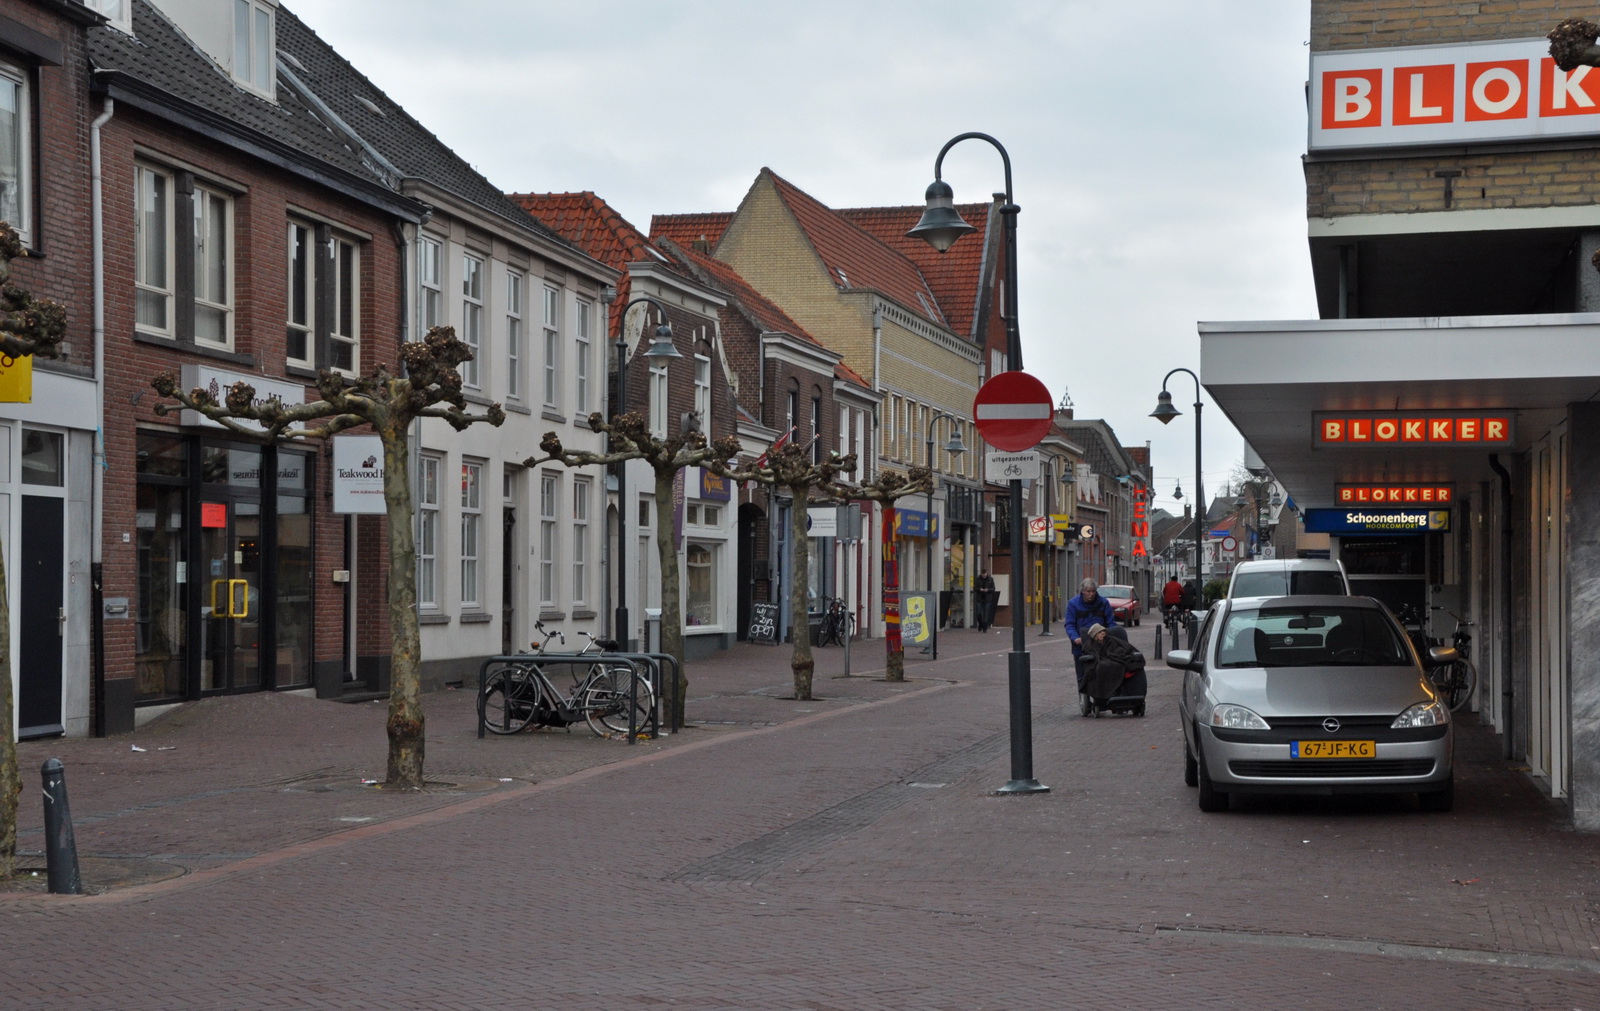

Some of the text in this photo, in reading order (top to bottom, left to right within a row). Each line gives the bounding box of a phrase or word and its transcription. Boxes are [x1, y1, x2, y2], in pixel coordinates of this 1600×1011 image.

[1325, 421, 1504, 439] BLOKKER
[991, 455, 1034, 463] uitgezonderd
[337, 468, 379, 479] Teakwood
[1342, 489, 1448, 501] BLOKKER
[1131, 483, 1149, 556] HEMA
[1346, 512, 1427, 526] Schoonenberg
